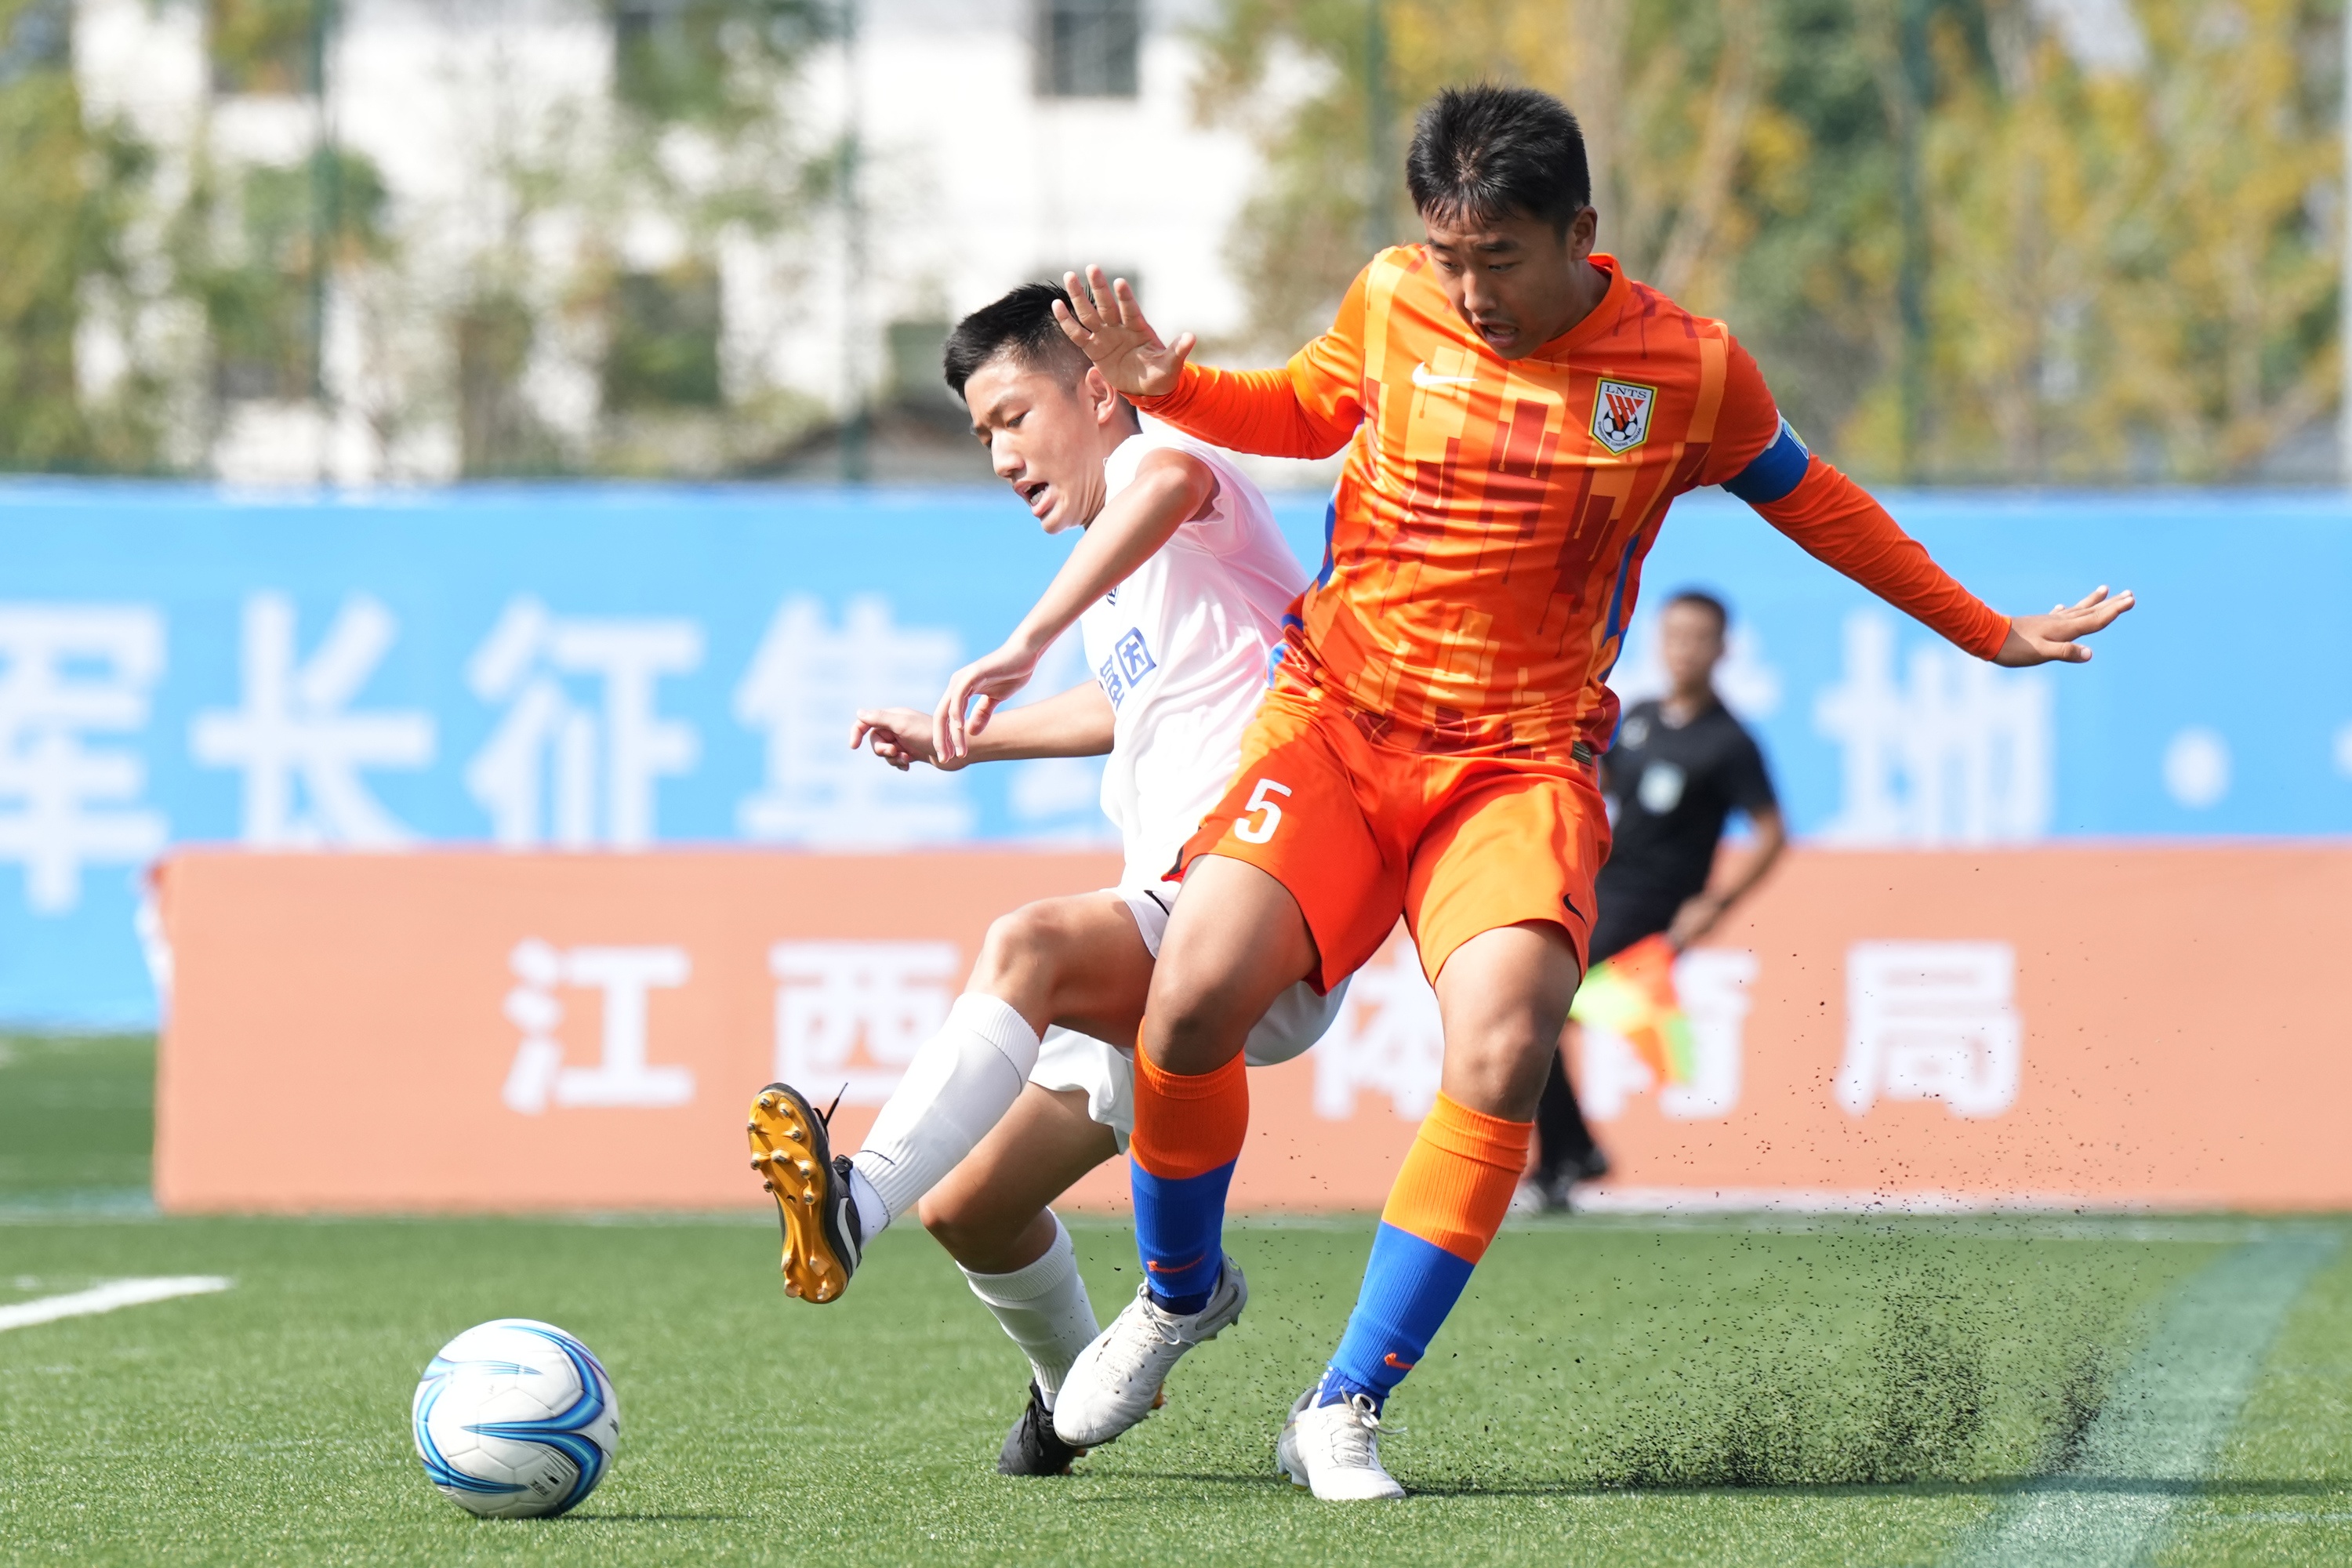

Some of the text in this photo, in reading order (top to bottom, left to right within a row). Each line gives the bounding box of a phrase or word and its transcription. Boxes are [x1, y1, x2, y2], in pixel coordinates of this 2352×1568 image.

[1605, 384, 1646, 399] LNTS
[1098, 626, 1157, 713] 基因
[1233, 778, 1294, 844] 5
